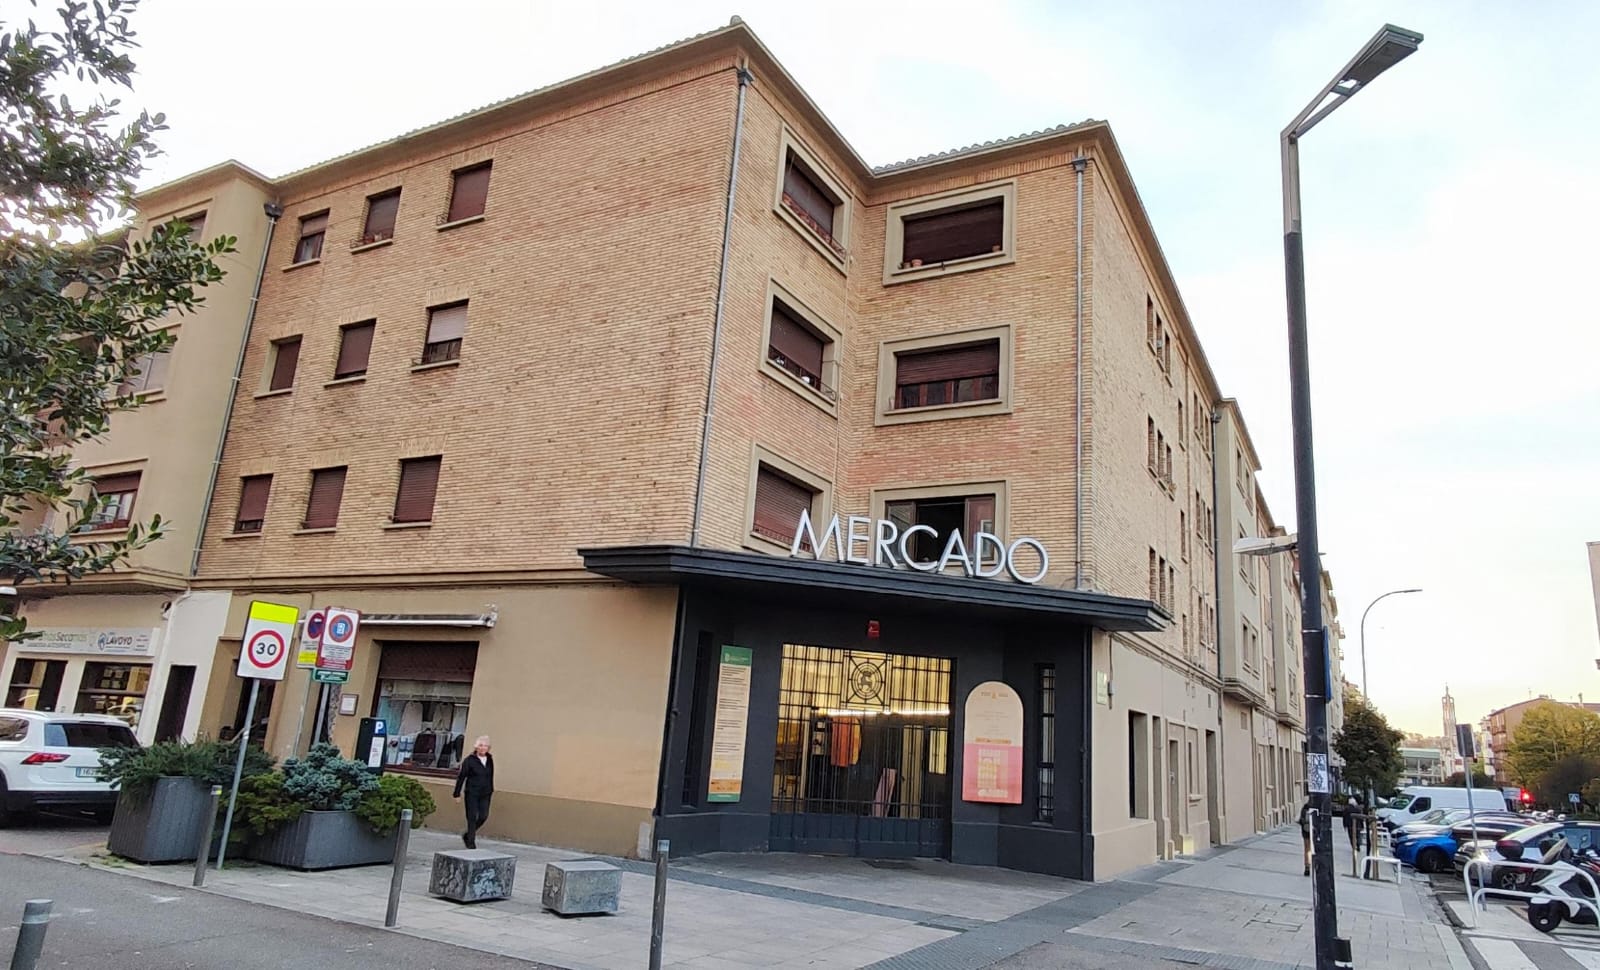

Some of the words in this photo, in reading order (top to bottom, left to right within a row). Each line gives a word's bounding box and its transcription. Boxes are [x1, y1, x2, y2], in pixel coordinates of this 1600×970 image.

[790, 507, 1049, 584] MERCADO
[255, 642, 277, 656] 30
[374, 721, 385, 735] P
